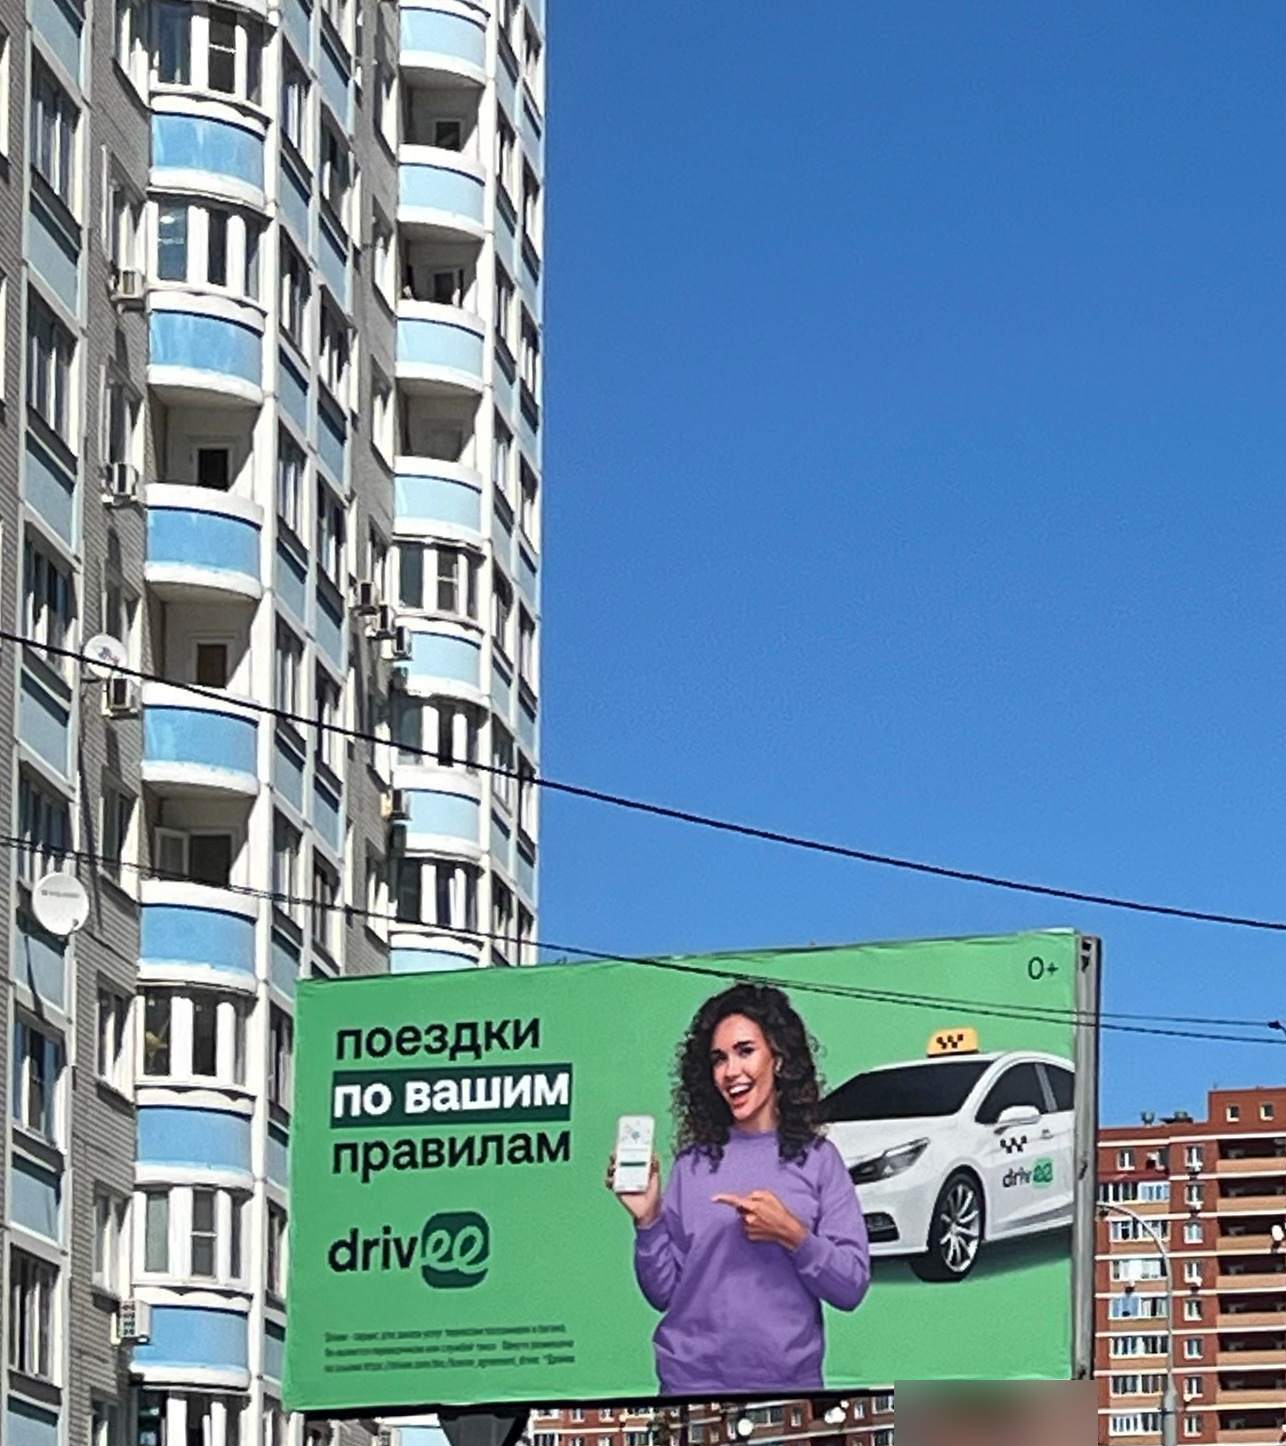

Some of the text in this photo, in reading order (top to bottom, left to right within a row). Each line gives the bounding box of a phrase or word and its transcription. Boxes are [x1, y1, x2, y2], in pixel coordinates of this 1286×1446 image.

[1027, 955, 1059, 981] 0+
[335, 1017, 541, 1062] поездки
[333, 1072, 571, 1119] по вашим
[331, 1130, 571, 1184] правилам
[327, 1221, 491, 1278] drivee
